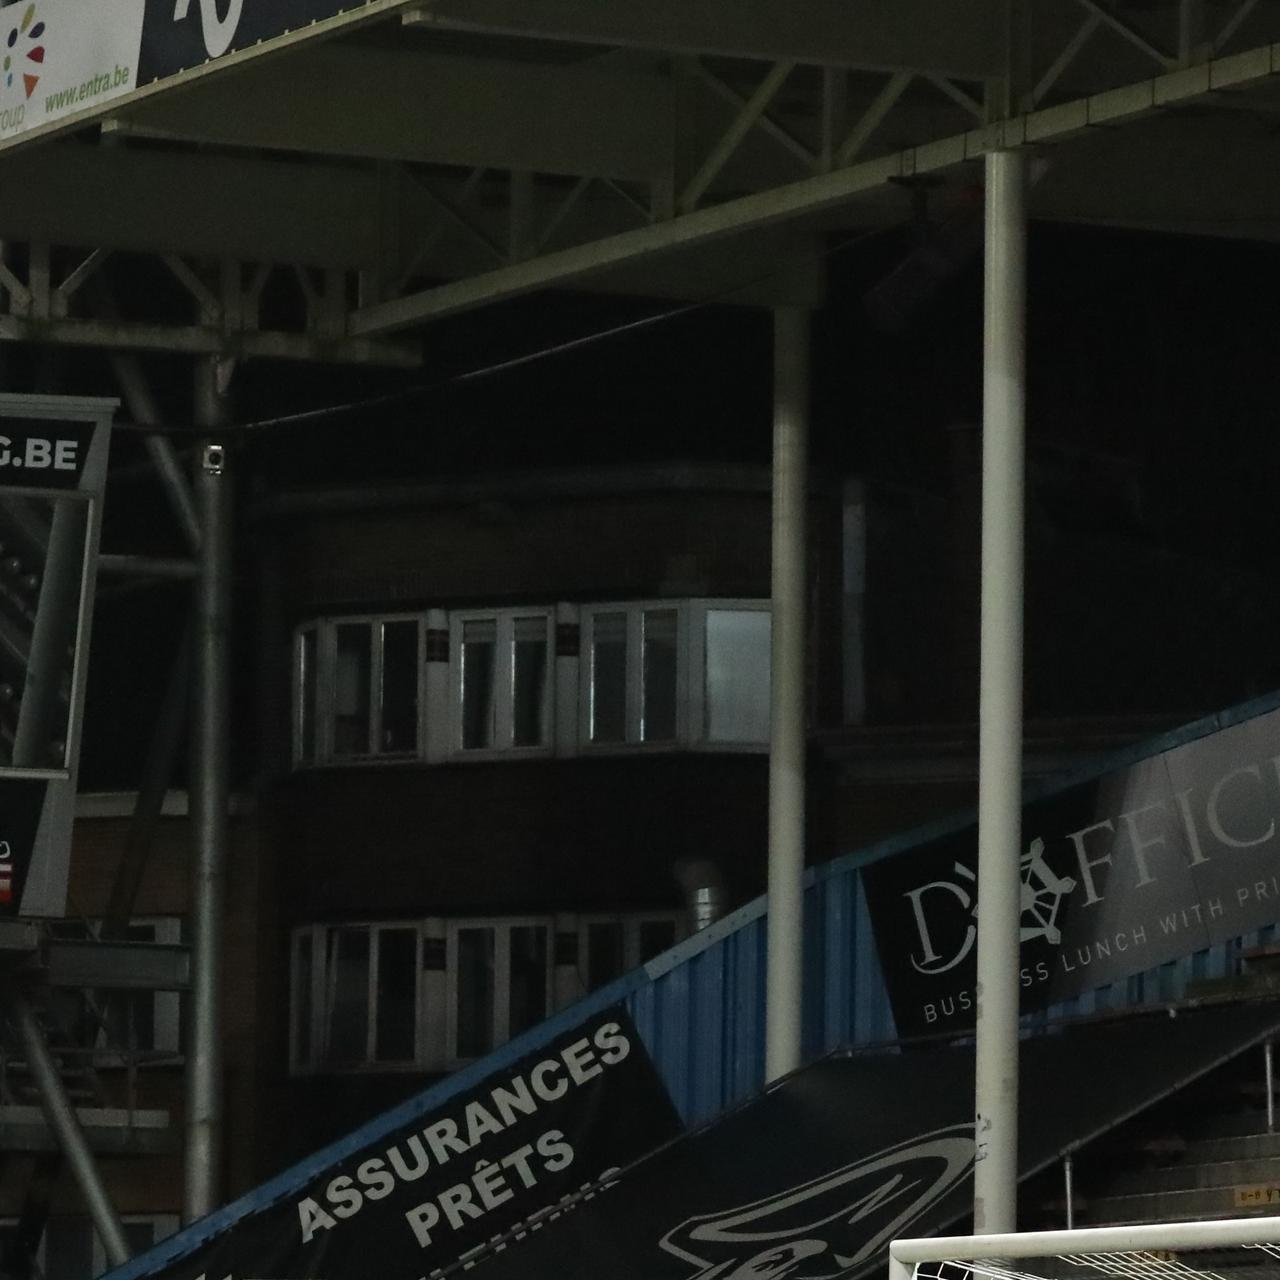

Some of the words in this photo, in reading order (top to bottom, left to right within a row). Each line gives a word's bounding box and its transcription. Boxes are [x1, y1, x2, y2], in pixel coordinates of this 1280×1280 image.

[44, 65, 130, 114] www.entra.be
[923, 962, 1049, 1024] BUSSS
[1062, 924, 1149, 972] LUNCH
[1159, 898, 1225, 936] WITH
[296, 1021, 632, 1245] ASSURANCES
[404, 1128, 576, 1249] PRÊTS
